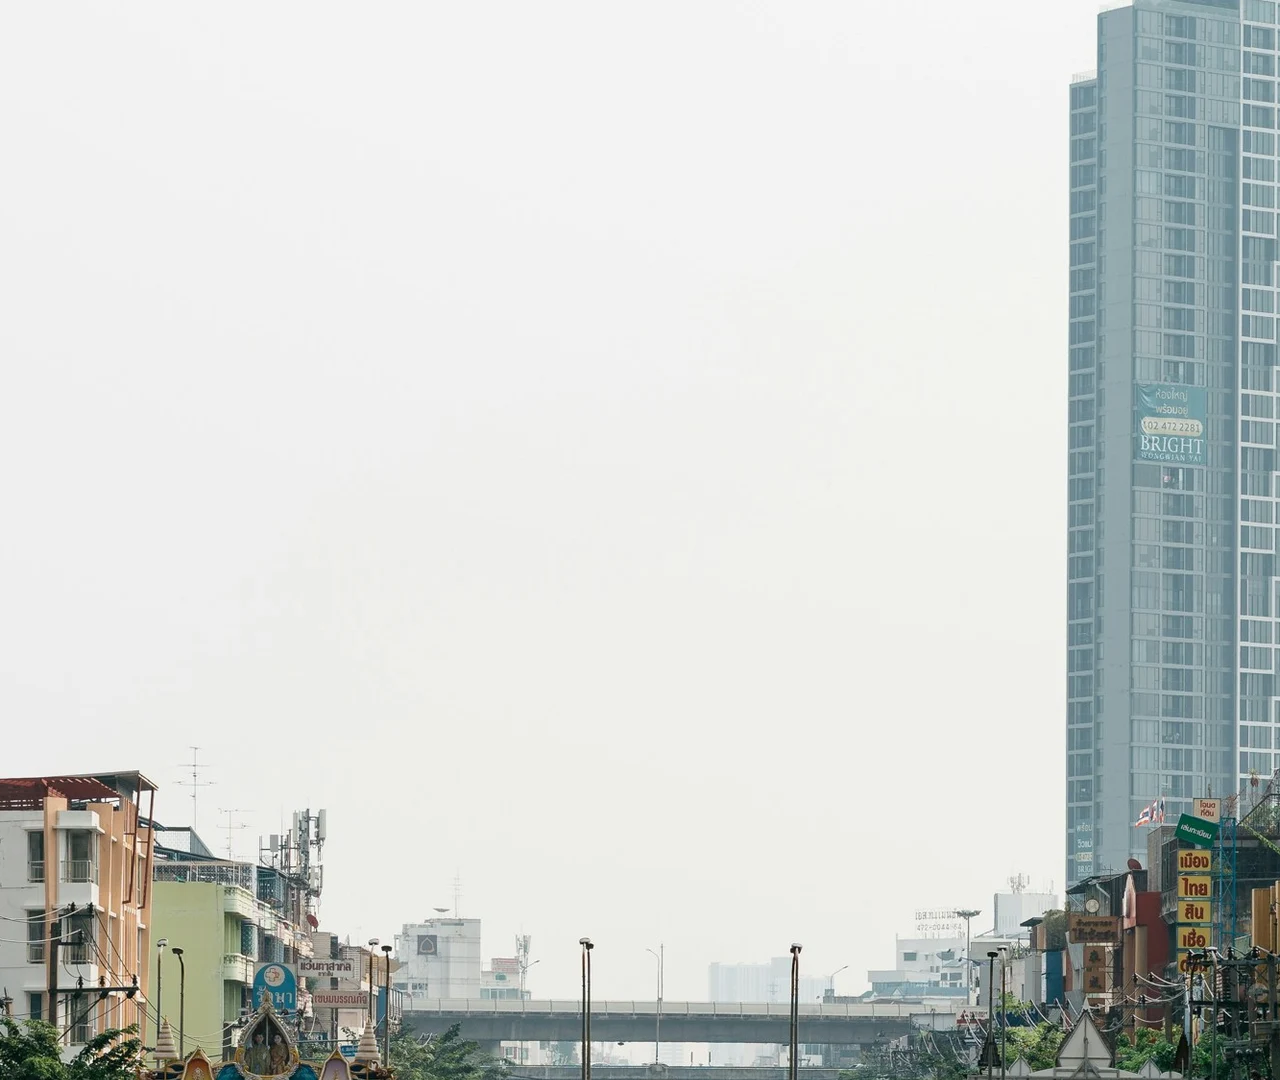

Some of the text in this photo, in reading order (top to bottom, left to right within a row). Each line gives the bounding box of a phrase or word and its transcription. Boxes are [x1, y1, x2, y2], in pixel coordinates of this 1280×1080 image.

[1148, 421, 1200, 433] 02 472 2281
[1141, 435, 1203, 454] BRIGHT
[1180, 852, 1209, 868] เมือง
[1182, 878, 1208, 896] ไทย
[1185, 904, 1204, 920] สิน
[1182, 929, 1206, 948] เชื่อ
[300, 960, 352, 971] แว่นตาสากล
